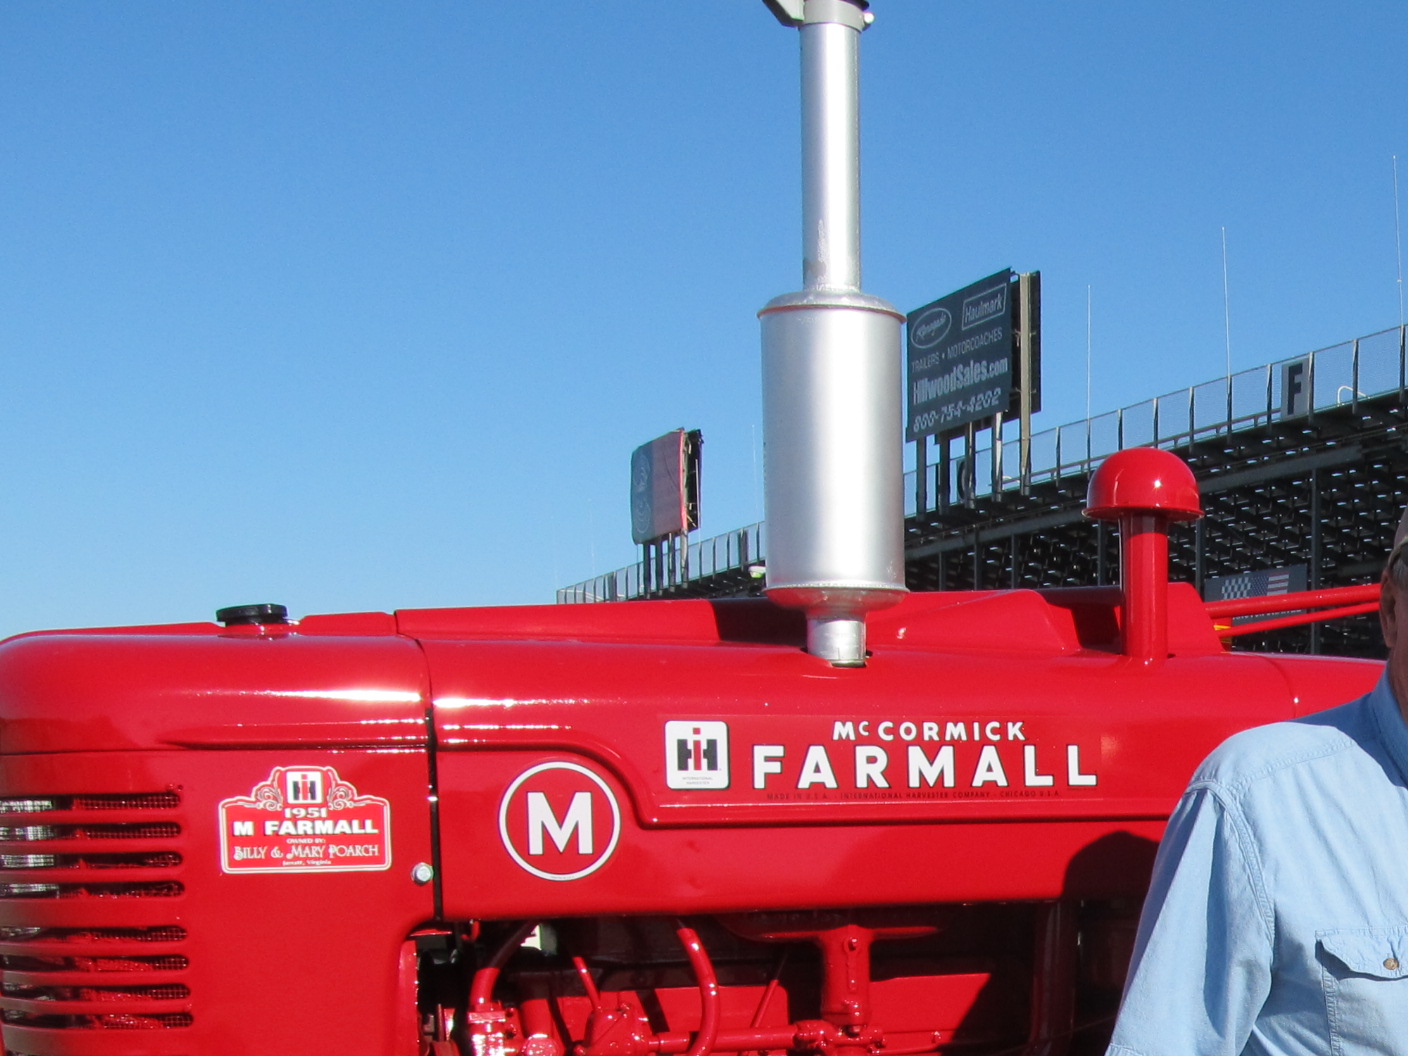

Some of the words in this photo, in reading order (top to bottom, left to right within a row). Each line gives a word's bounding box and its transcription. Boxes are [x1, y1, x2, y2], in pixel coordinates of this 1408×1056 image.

[964, 293, 1003, 324] Haulmark
[911, 351, 940, 373] TRAILERS
[947, 327, 1002, 360] MOTORCOACHES
[913, 357, 1008, 405] HillwoodSales.com
[1287, 363, 1303, 415] F
[752, 744, 1098, 790] FARMALL
[285, 807, 328, 819] 1951
[840, 792, 903, 800] INTERNATIONAL
[906, 791, 949, 799] HARVESTER
[952, 791, 990, 799] COMPANY
[1000, 790, 1037, 798] CHICAGO
[233, 821, 255, 836] M
[264, 819, 379, 836] FARMALL
[526, 791, 594, 855] M
[233, 845, 268, 861] BILLY
[286, 845, 326, 860] MARY
[328, 844, 379, 859] POARCH
